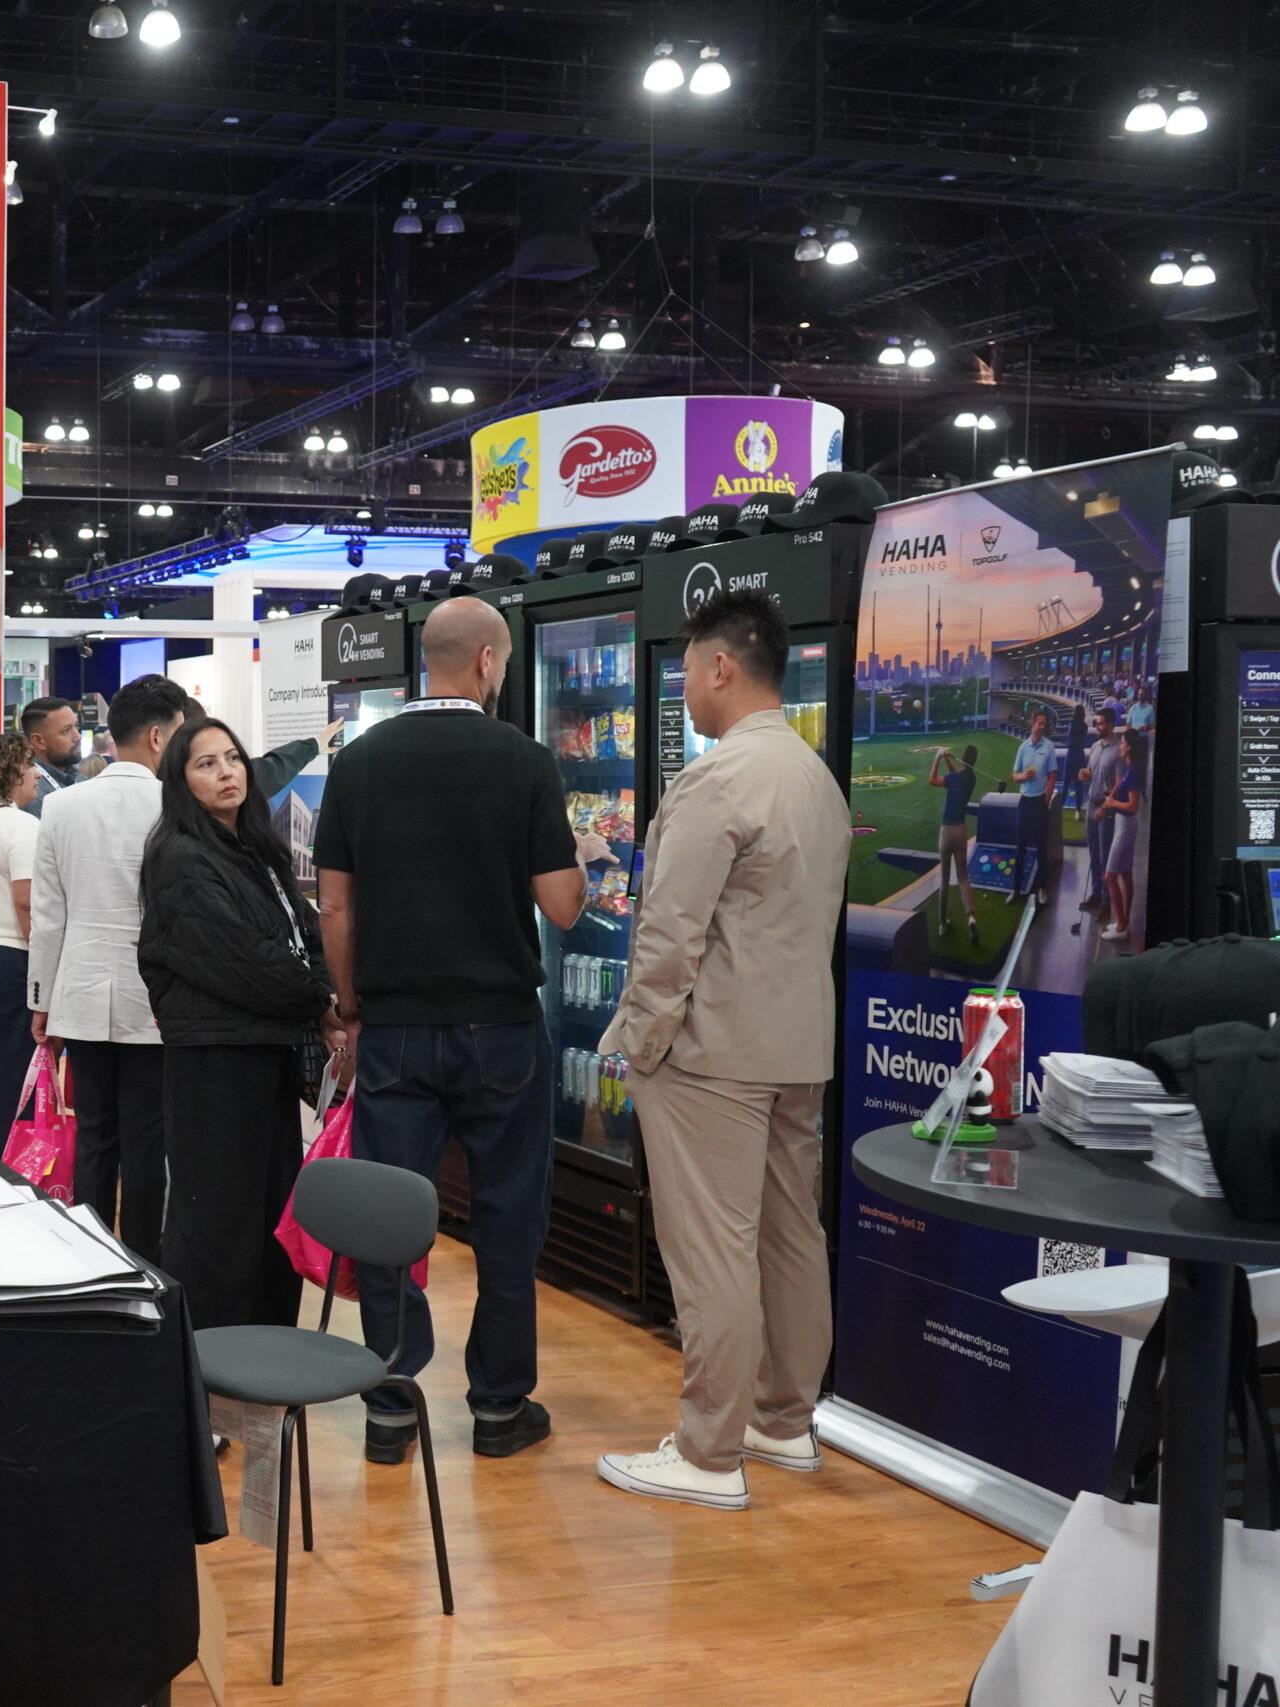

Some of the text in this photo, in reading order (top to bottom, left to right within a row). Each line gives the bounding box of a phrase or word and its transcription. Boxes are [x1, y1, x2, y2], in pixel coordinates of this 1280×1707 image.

[560, 436, 653, 508] Gardetto's
[712, 471, 796, 498] Annie's
[793, 531, 824, 545] Pro 542
[881, 534, 947, 564] HAHA
[880, 560, 948, 577] VENDING
[971, 553, 1009, 566] TOPGOLF
[729, 572, 768, 592] SMART
[359, 632, 379, 645] SMART
[360, 648, 385, 661] VENDING
[268, 684, 328, 704] Company Introduc
[867, 997, 965, 1044] Exclusiv
[863, 1096, 882, 1109] Join
[884, 1099, 907, 1113] HAHA
[859, 1203, 927, 1232] Wednesday, April 22
[925, 1318, 1010, 1356] www.hahavending.com
[923, 1331, 1011, 1372] sales@hahavending.com
